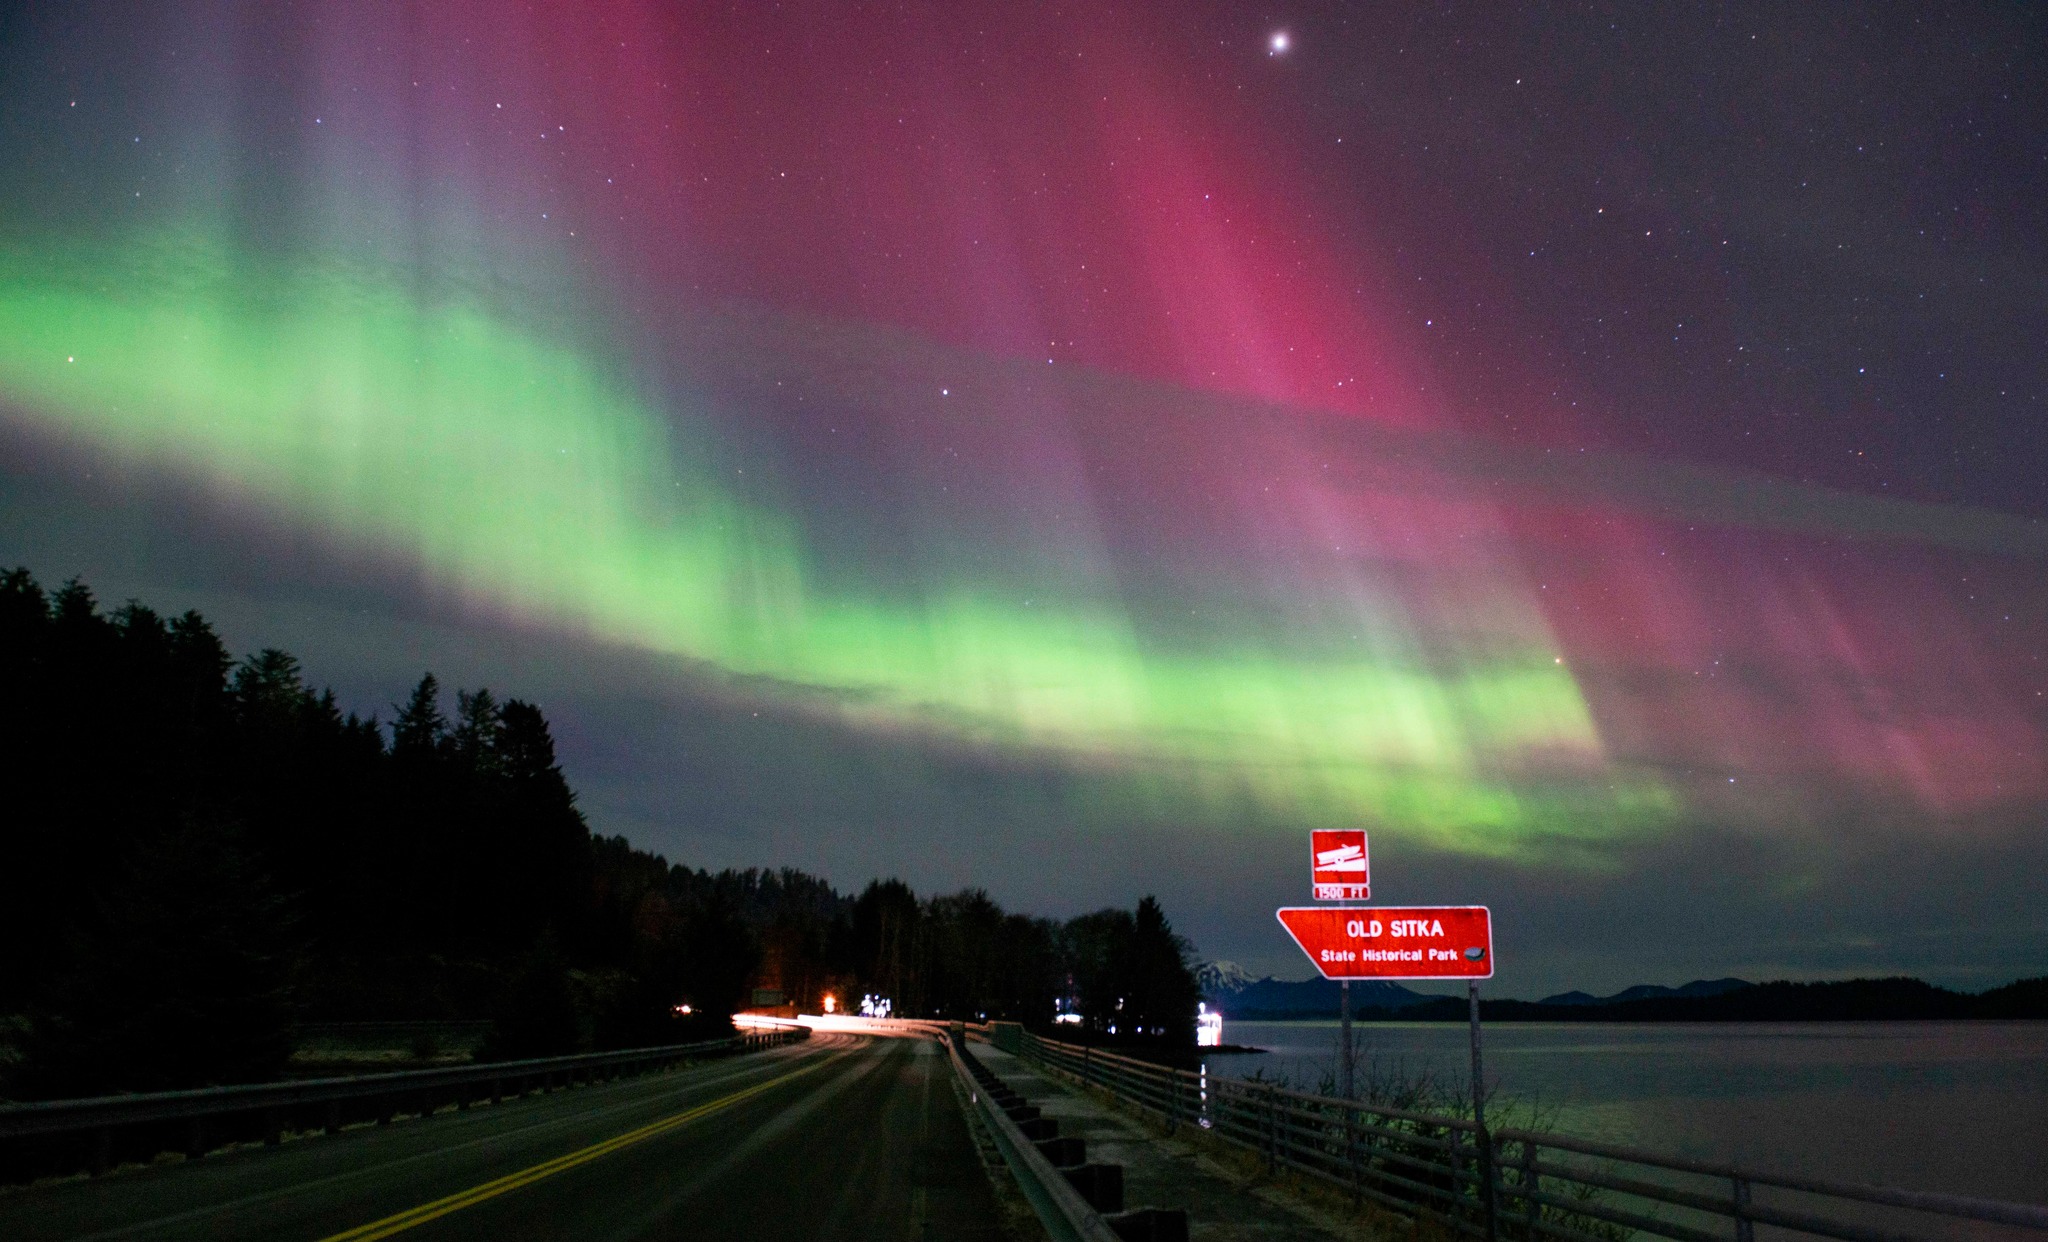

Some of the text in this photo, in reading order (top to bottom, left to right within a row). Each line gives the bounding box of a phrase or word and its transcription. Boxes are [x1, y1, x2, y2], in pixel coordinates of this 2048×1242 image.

[1318, 887, 1363, 899] 1500 FT
[1346, 920, 1444, 938] OLD SITKA
[1321, 948, 1458, 962] State Historical Park
